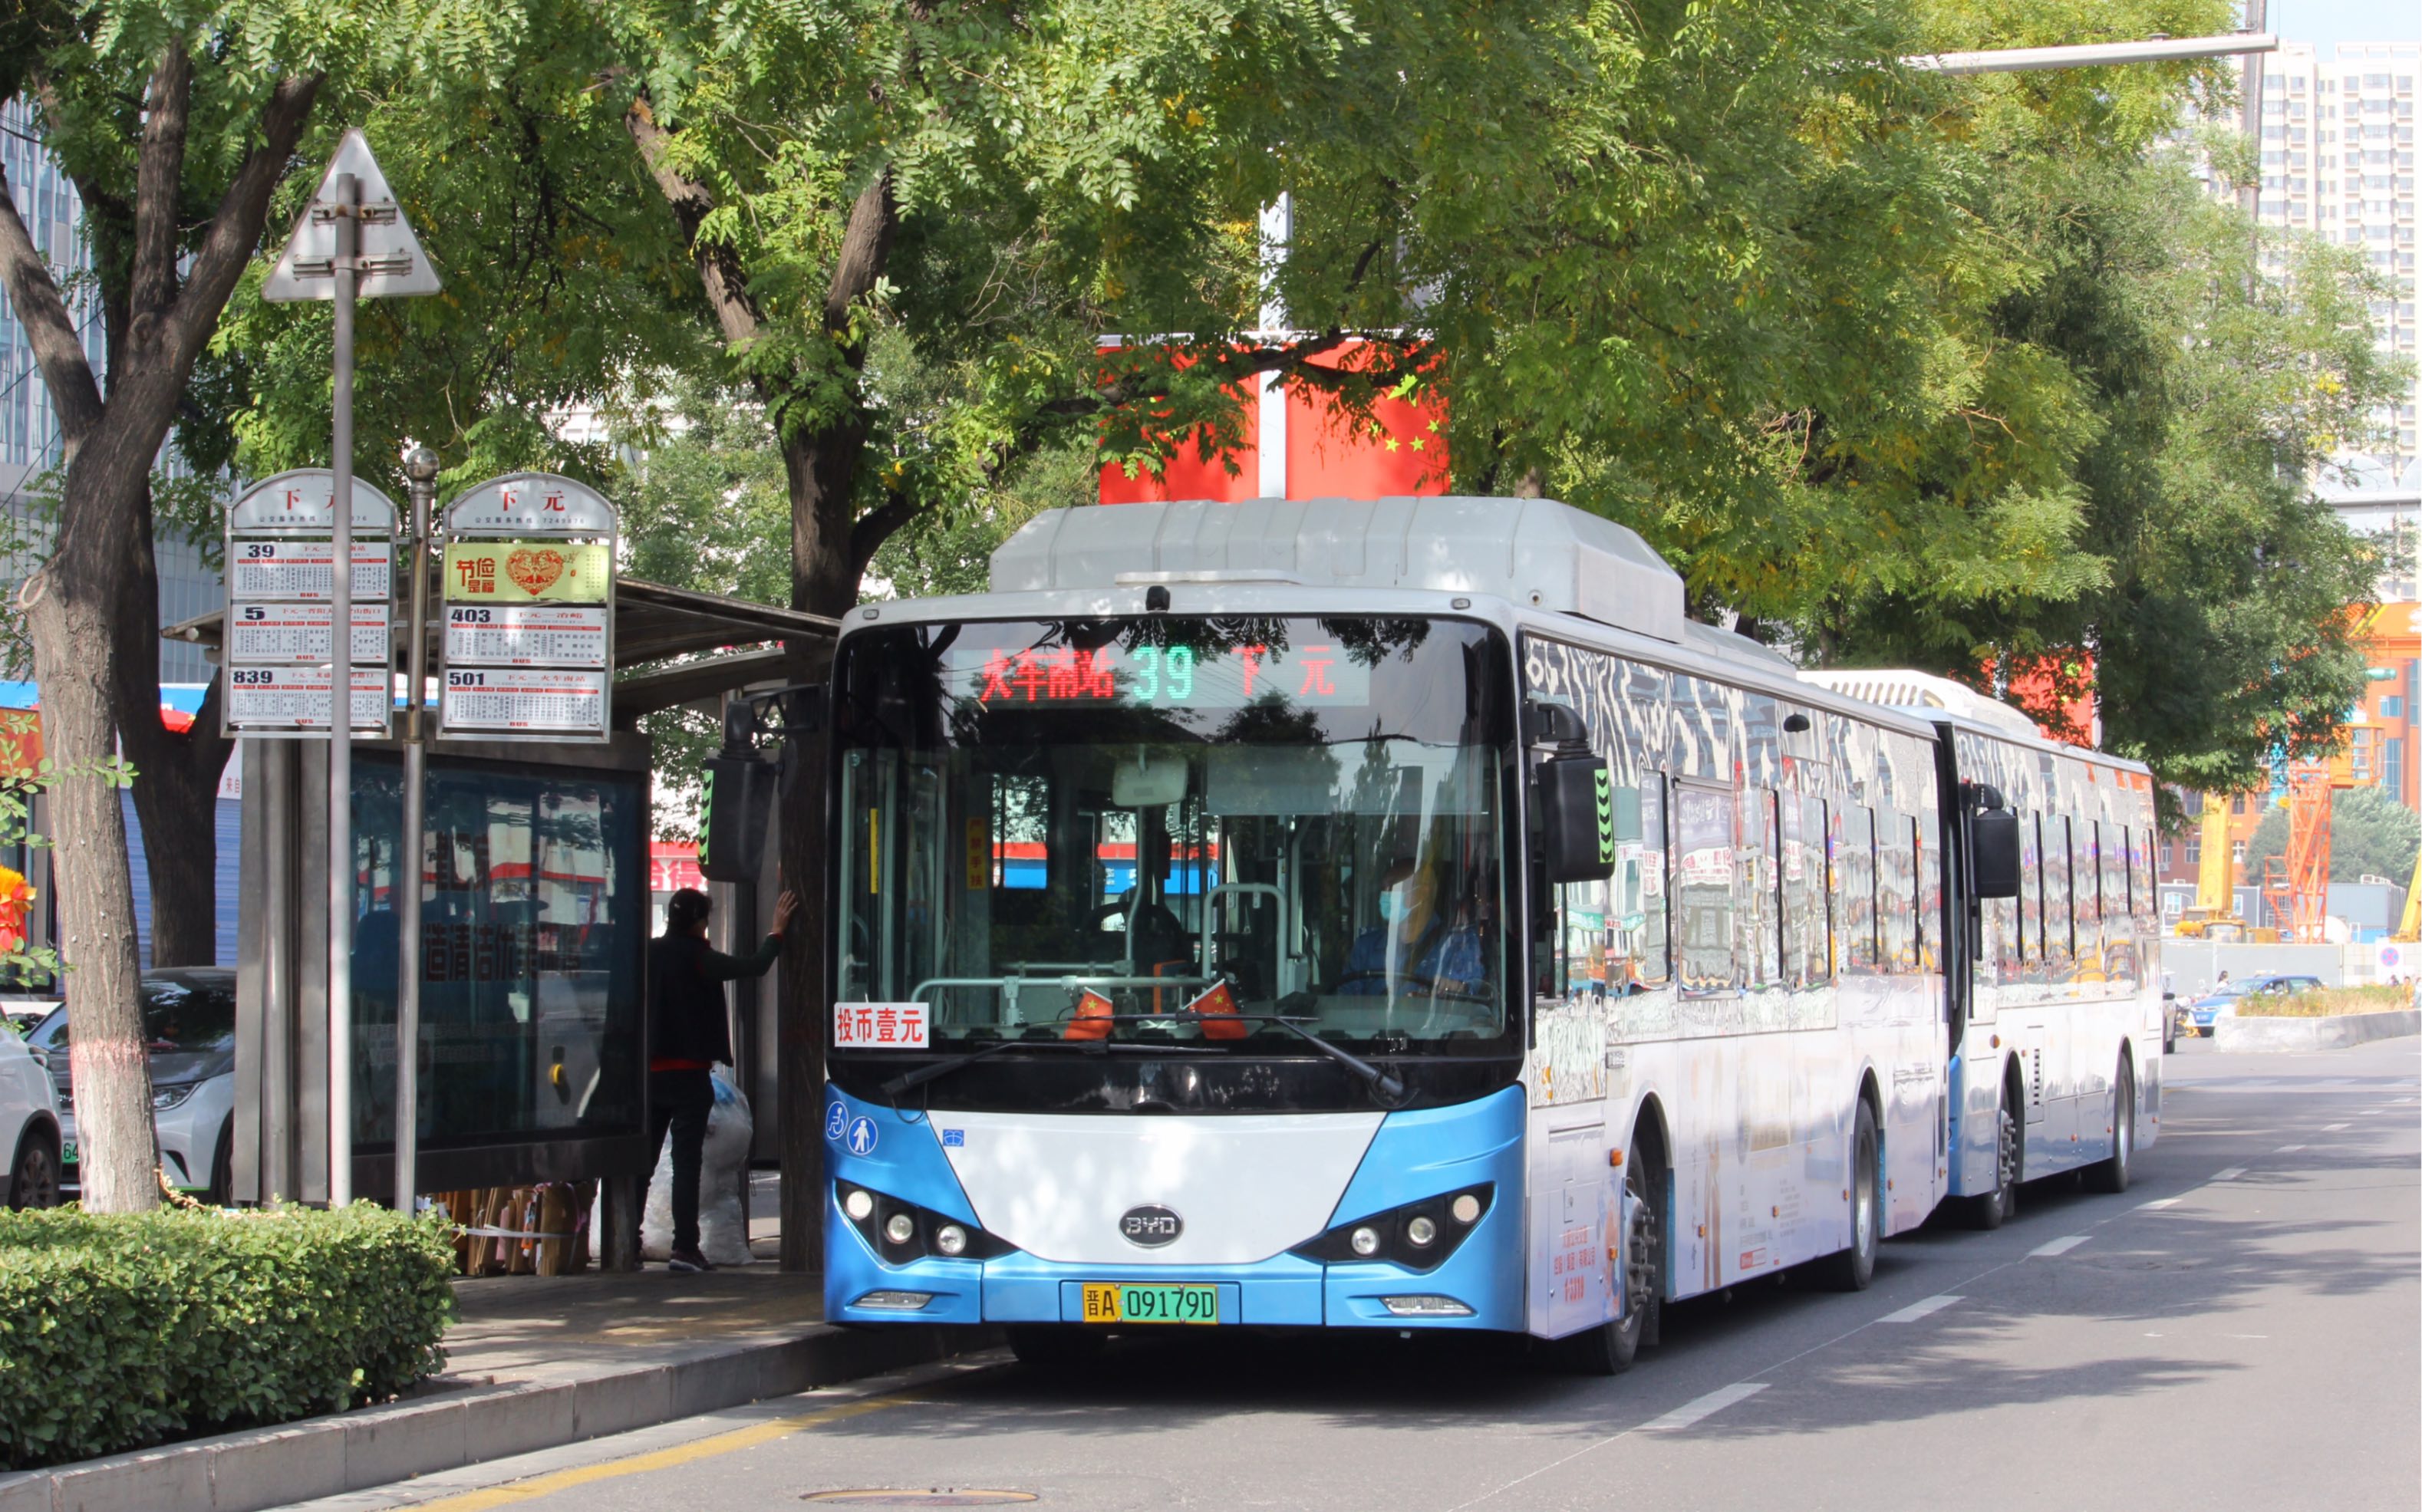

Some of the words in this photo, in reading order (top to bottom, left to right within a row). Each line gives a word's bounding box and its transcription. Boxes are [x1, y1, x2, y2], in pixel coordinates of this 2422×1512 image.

[495, 489, 565, 512] 下元
[248, 545, 275, 558] 39
[245, 607, 265, 621] 5
[450, 609, 491, 623] 403
[233, 670, 273, 684] 839
[449, 672, 485, 686] 501
[979, 648, 1115, 702] 火车南站
[1132, 645, 1195, 700] 39
[1232, 644, 1336, 697] 下元
[837, 1007, 924, 1043] 投币壹元
[1125, 1217, 1175, 1234] BYD
[1126, 1290, 1214, 1319] 09179D
